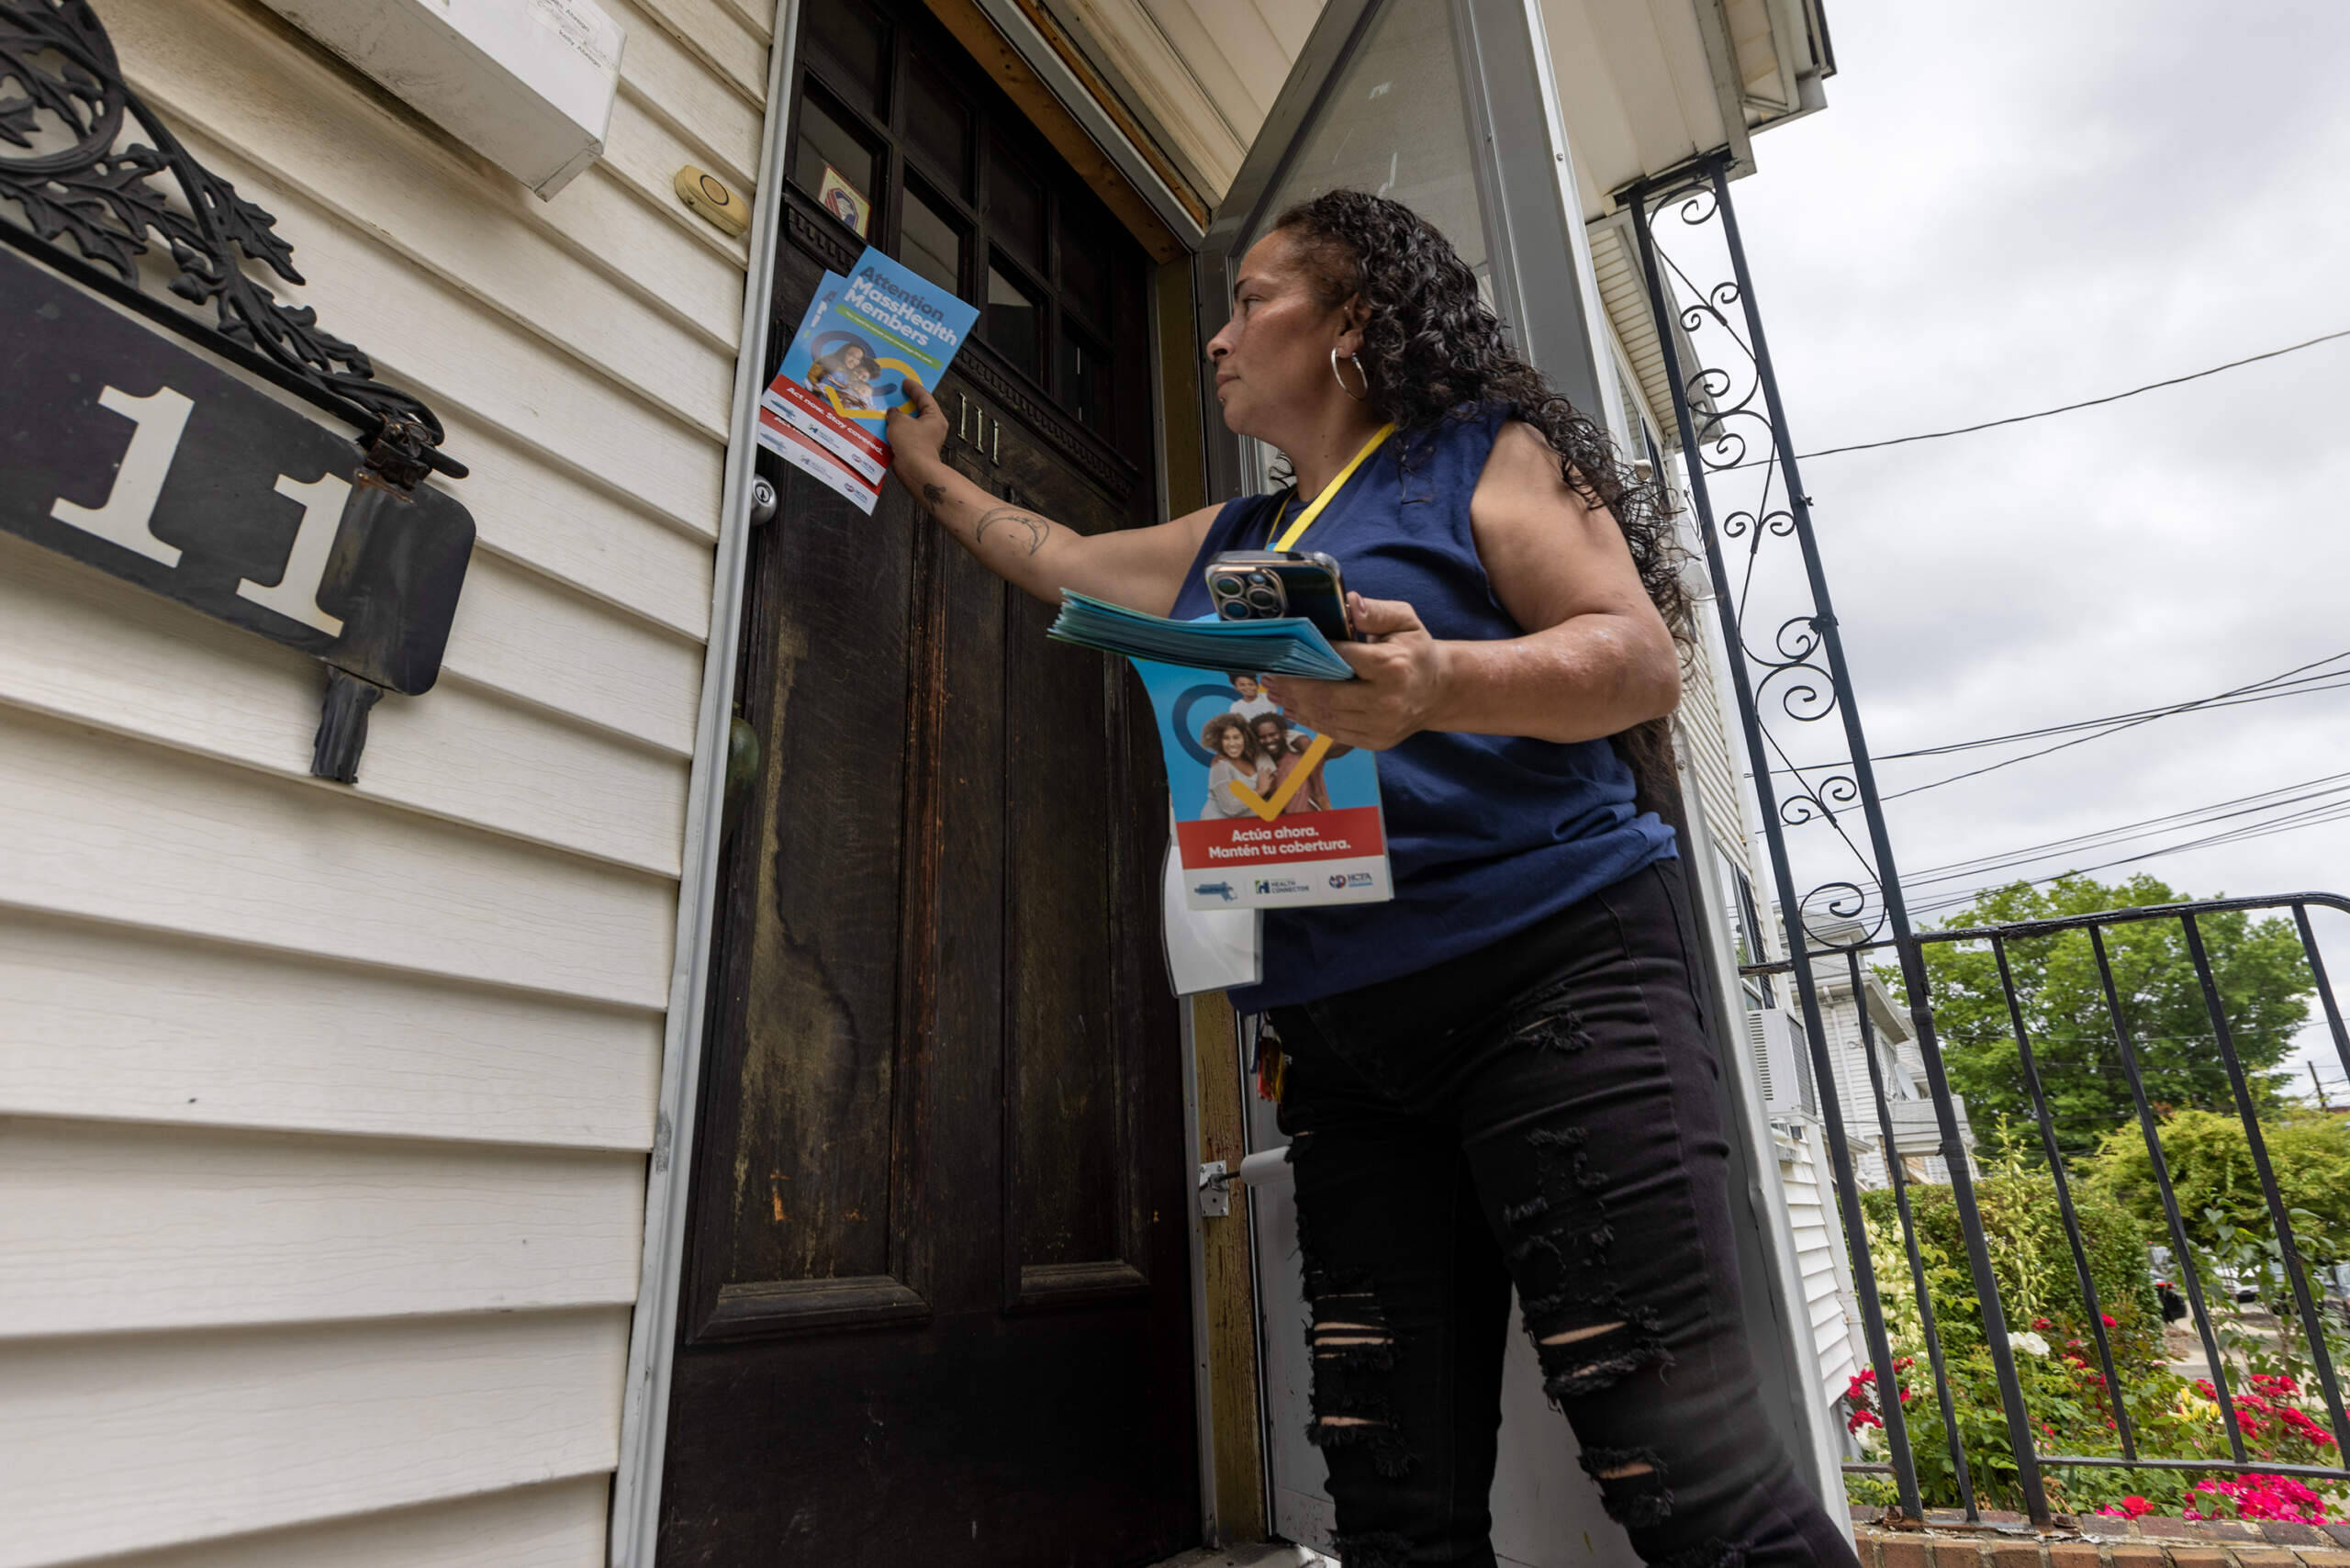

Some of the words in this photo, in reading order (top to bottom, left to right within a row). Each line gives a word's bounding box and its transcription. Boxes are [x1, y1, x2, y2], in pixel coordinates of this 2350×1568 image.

[845, 288, 929, 346] Members
[852, 276, 957, 345] MassHealth
[859, 266, 944, 321] Attention
[787, 386, 804, 400] Act
[803, 398, 825, 416] now.
[825, 411, 847, 429] Stay
[846, 427, 883, 456] covered.
[1208, 844, 1260, 859] Mantén
[1261, 843, 1277, 855] tu
[1279, 838, 1352, 855] cobertura.
[1232, 827, 1272, 843] Actúa
[1274, 826, 1320, 840] ahora.
